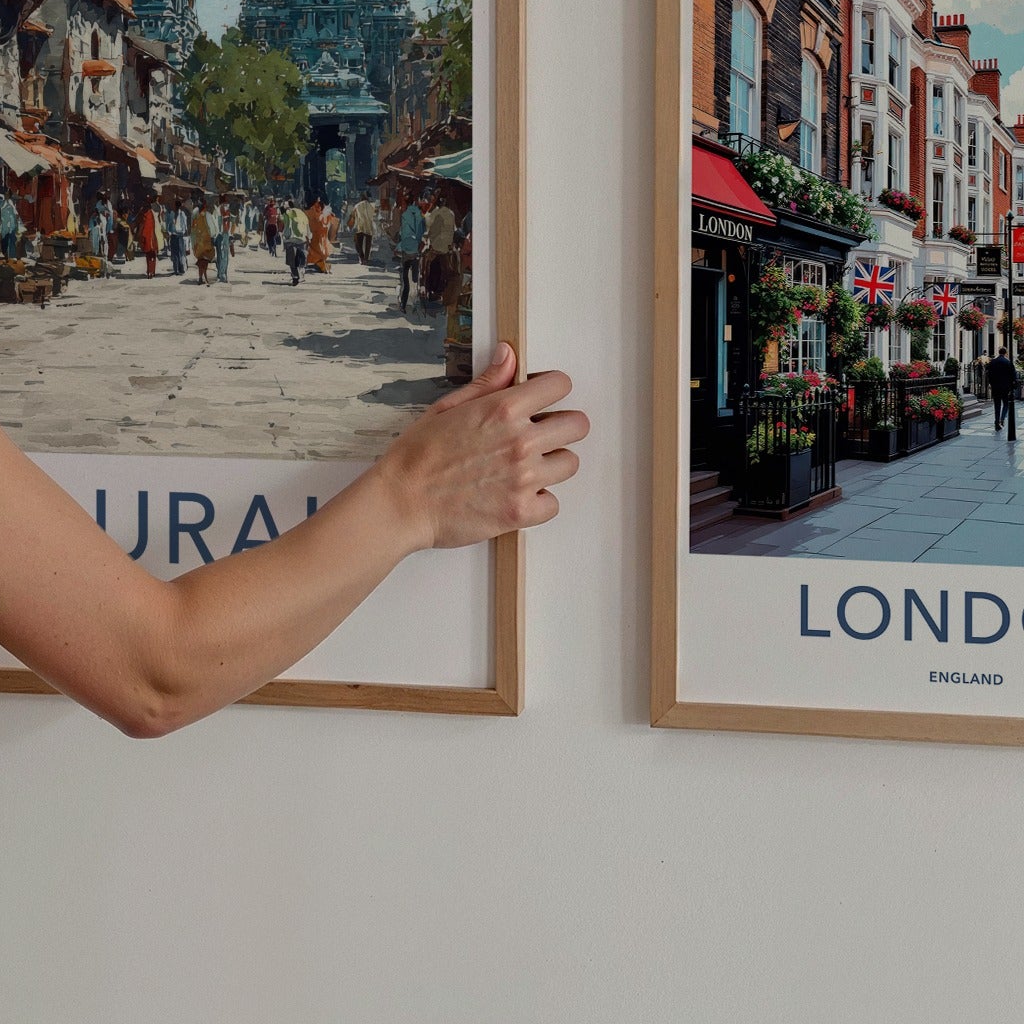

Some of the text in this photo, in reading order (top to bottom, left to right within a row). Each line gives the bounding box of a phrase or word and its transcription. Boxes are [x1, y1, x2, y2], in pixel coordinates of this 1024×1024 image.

[698, 213, 753, 243] LONDON
[800, 584, 1024, 645] LOND
[929, 671, 1004, 686] ENGLAND
